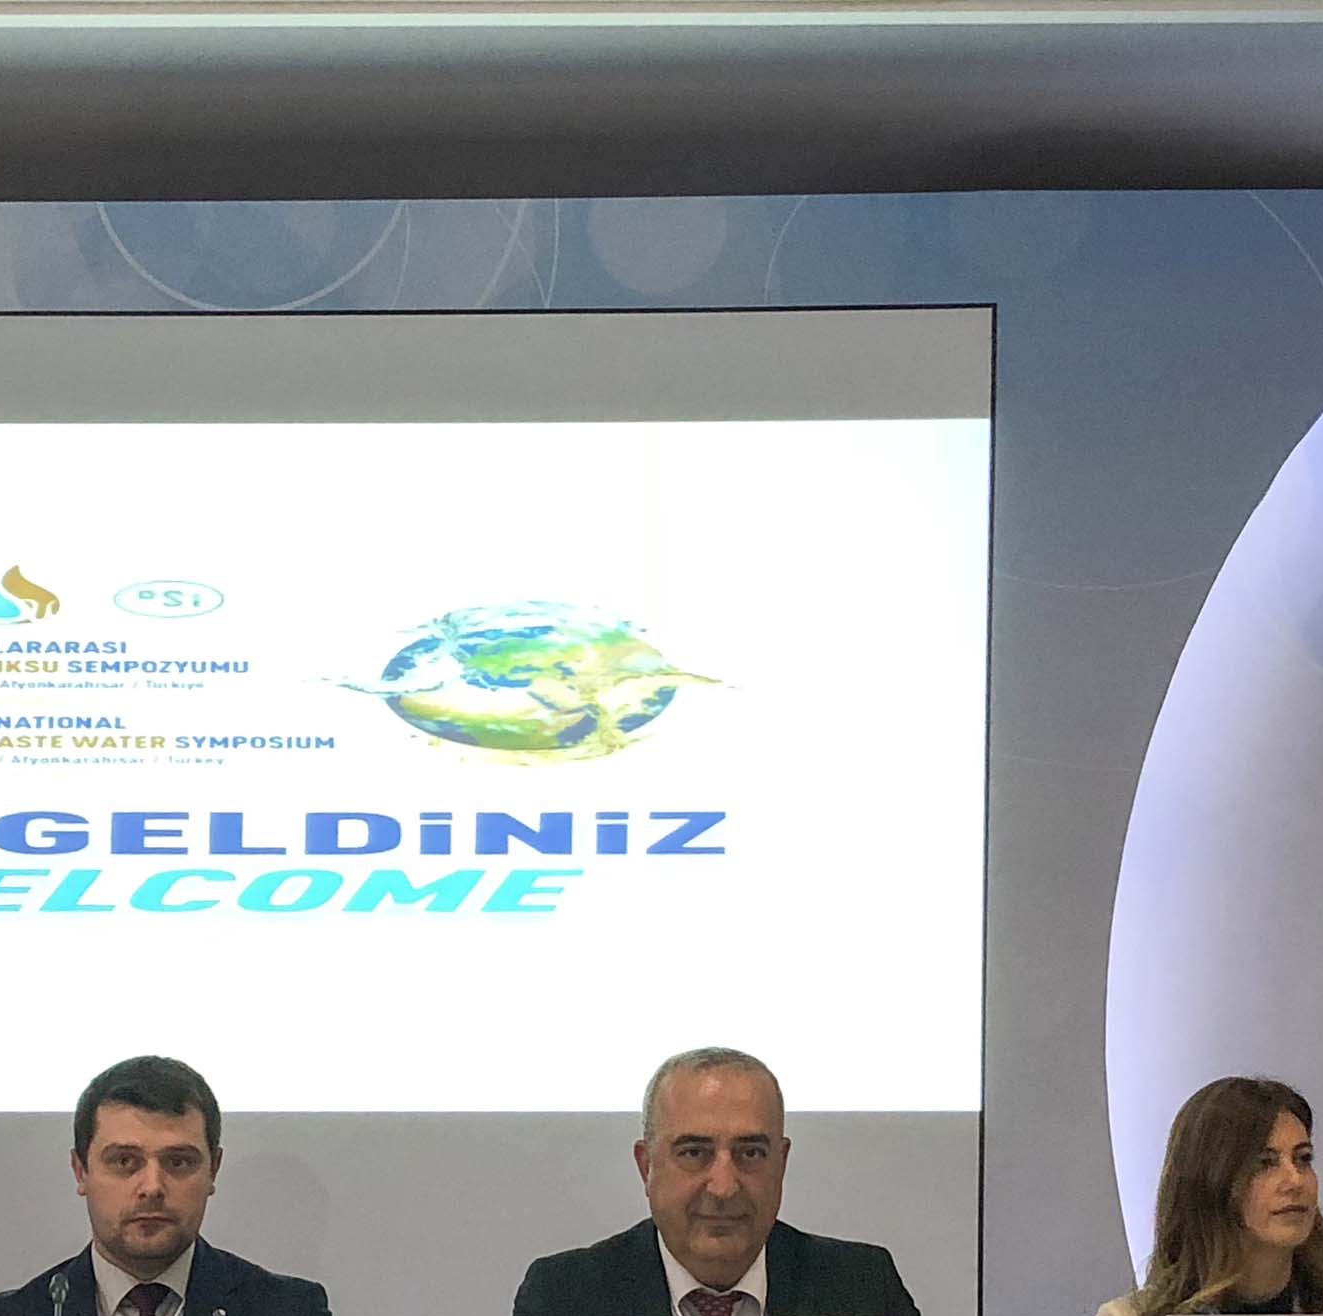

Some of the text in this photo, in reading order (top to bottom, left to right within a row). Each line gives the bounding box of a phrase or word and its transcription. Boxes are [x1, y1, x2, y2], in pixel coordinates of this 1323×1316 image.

[67, 660, 249, 673] SEMPOZYUMU
[72, 736, 166, 748] WATER
[175, 736, 335, 749] SYMPOSIUM
